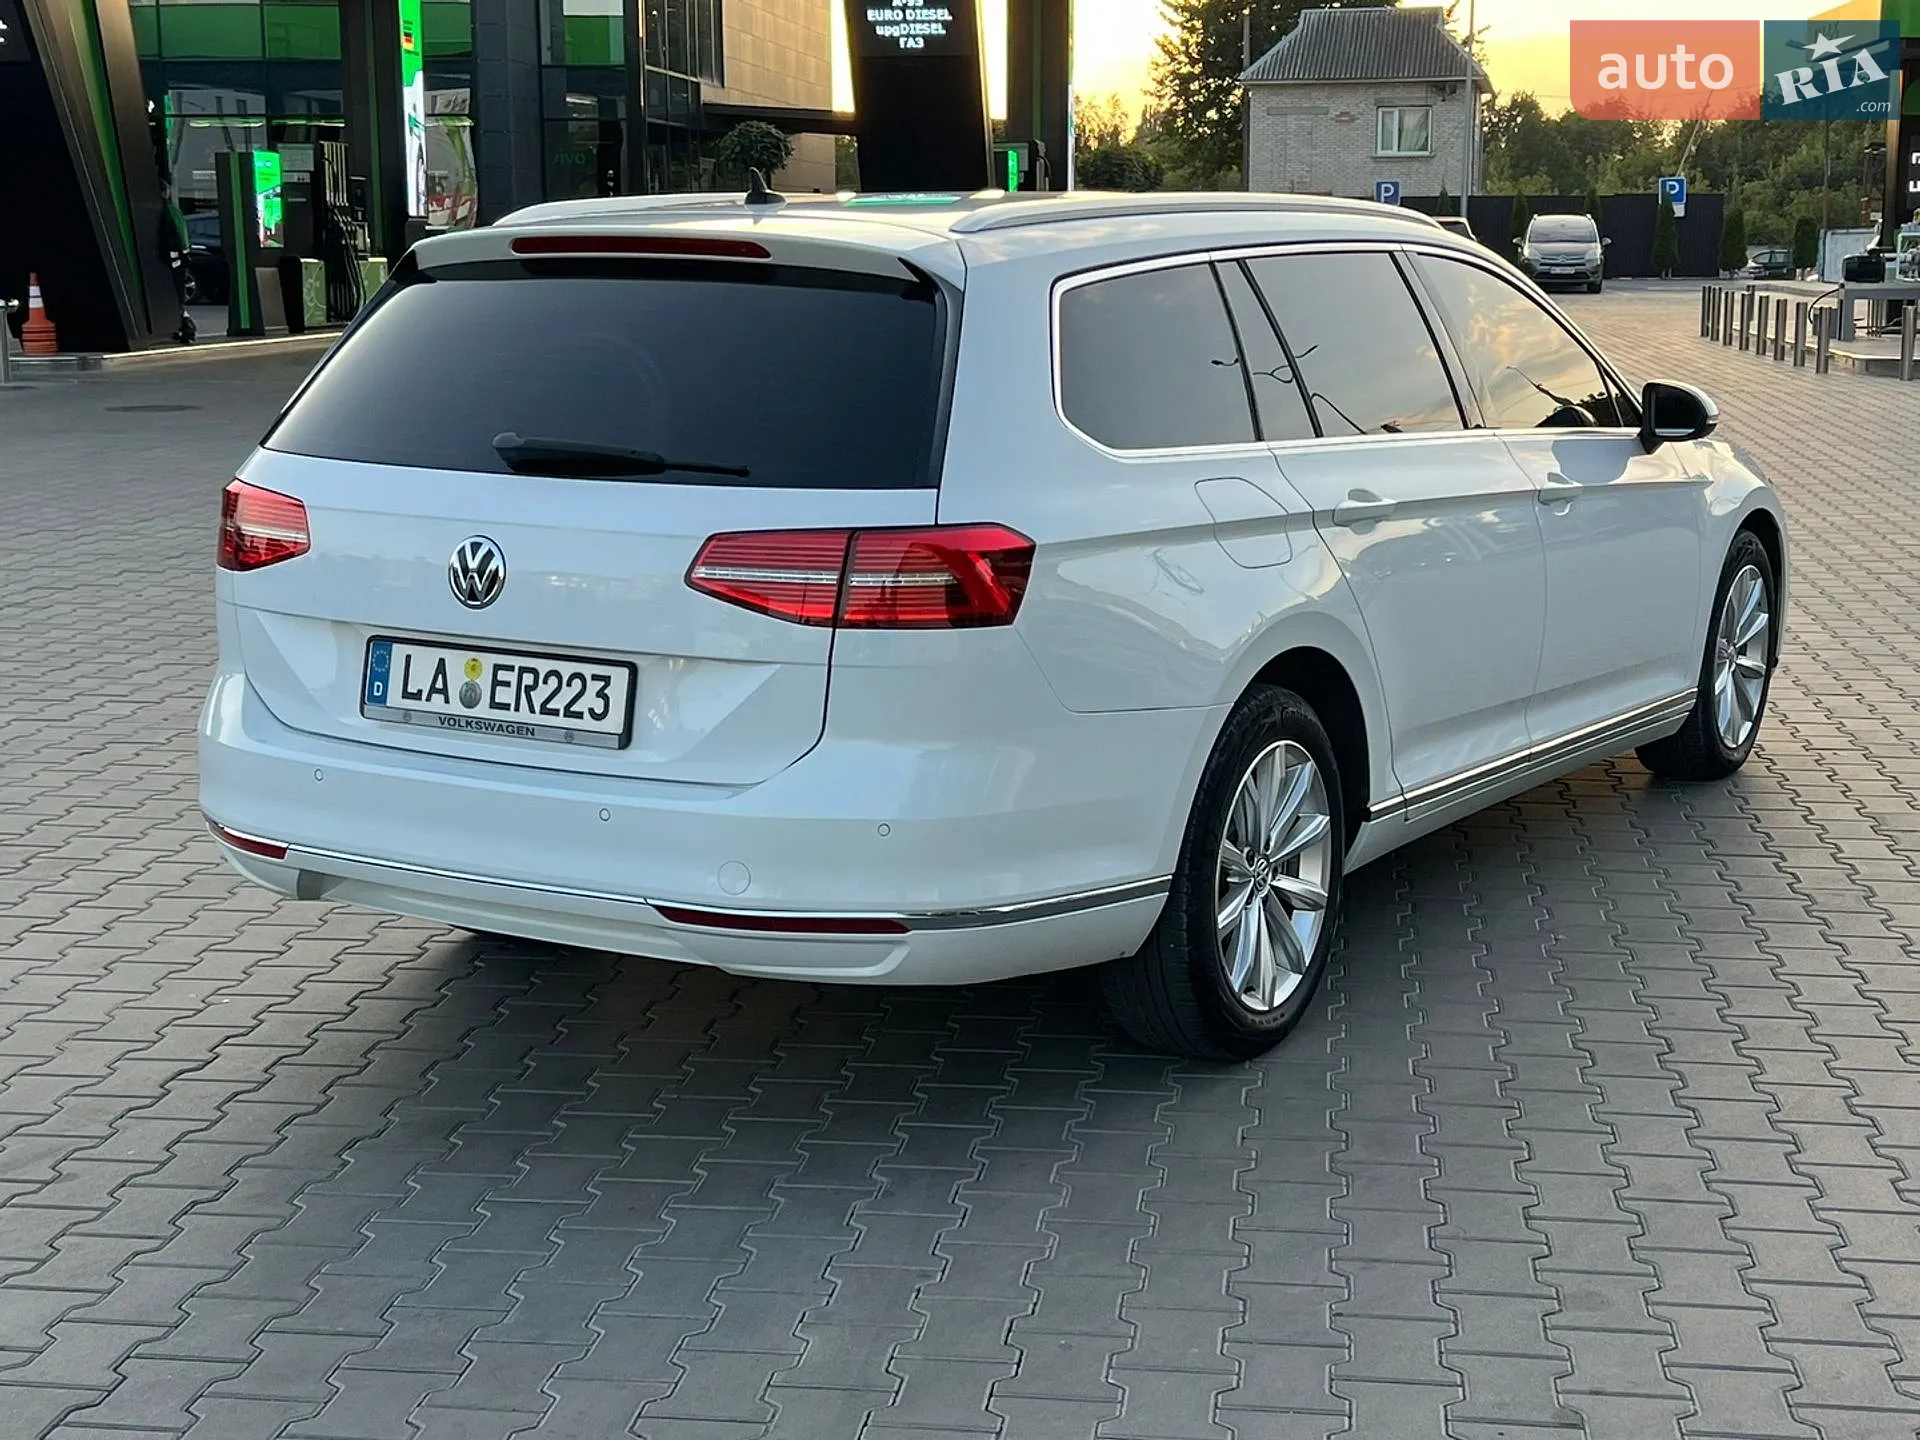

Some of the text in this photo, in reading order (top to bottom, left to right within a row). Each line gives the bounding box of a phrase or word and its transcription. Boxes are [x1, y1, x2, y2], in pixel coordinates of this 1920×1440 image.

[866, 8, 953, 21] EURO DIESEL
[875, 23, 947, 37] upgDIESEL
[899, 37, 924, 49] ГАЗ
[1381, 183, 1395, 204] P
[1666, 181, 1680, 195] P
[373, 654, 612, 722] D LA ER223
[438, 716, 536, 737] VOLKSWAGEN
